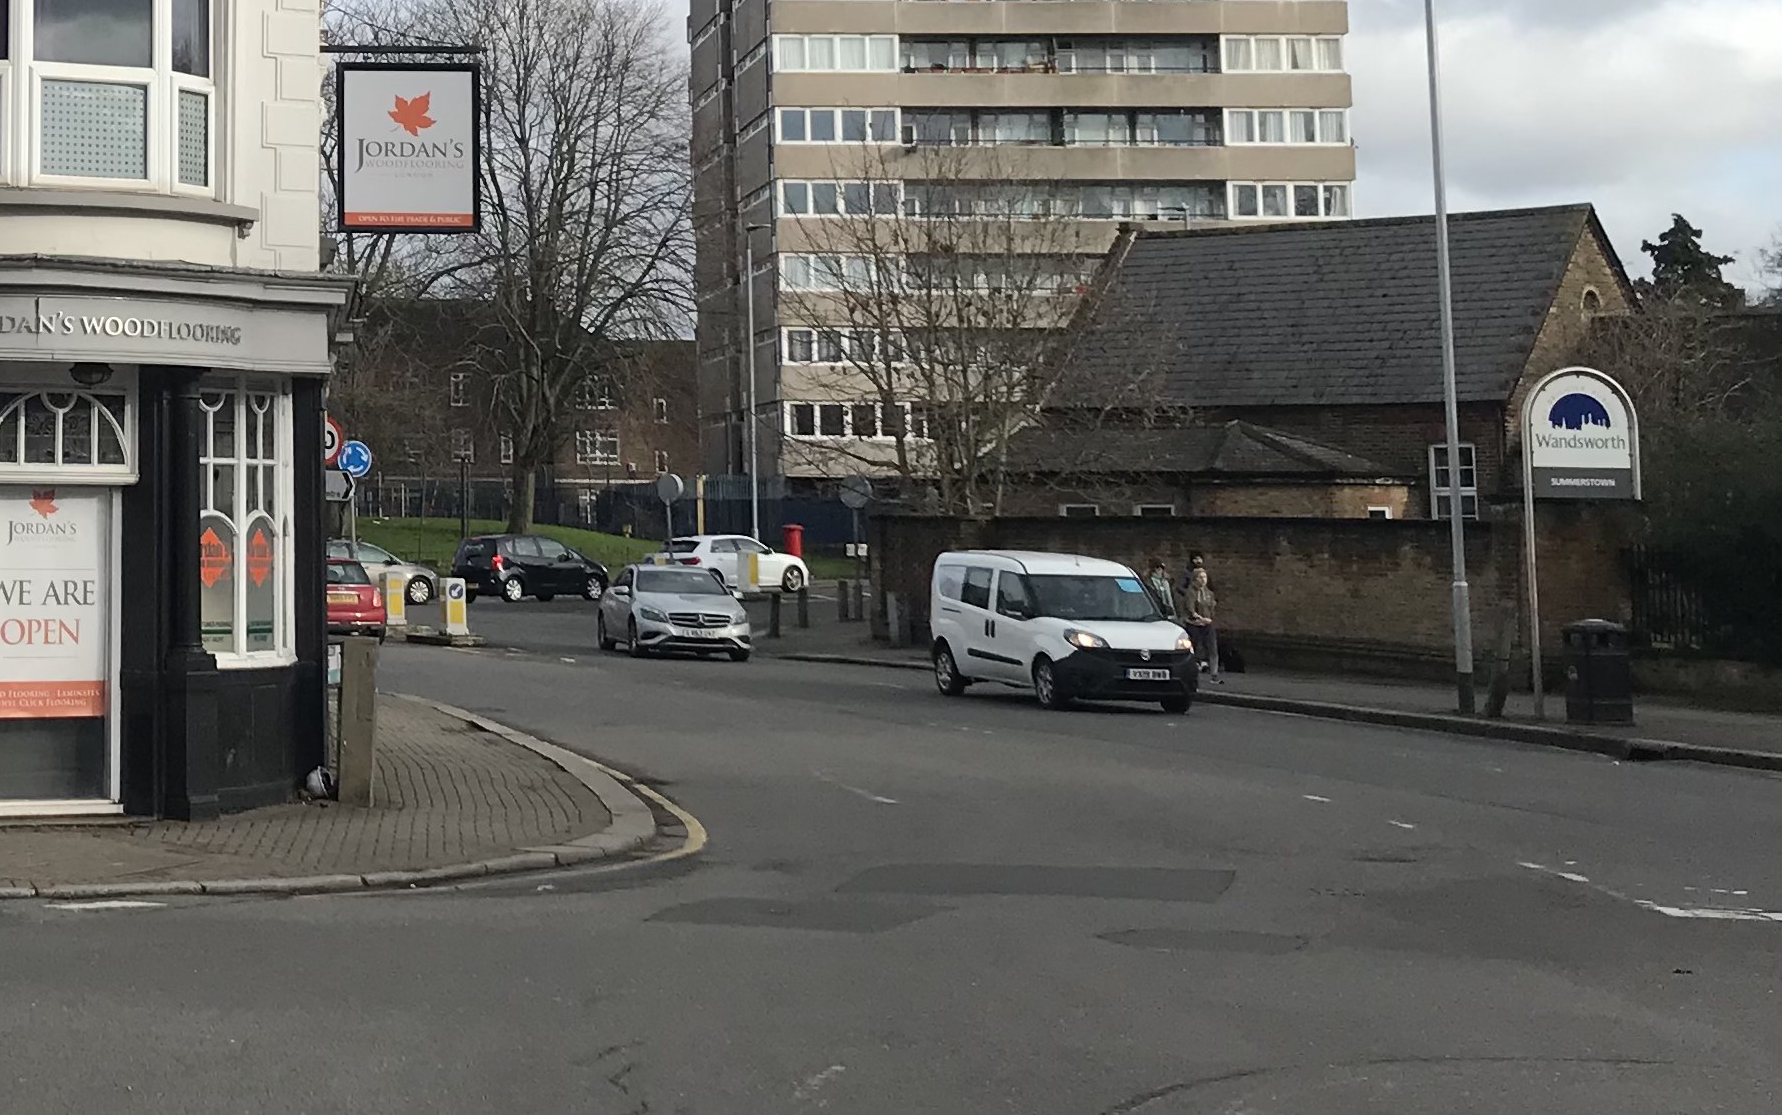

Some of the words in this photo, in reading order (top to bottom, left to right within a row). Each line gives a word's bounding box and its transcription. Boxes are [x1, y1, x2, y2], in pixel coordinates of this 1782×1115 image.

[355, 138, 464, 173] JORDAN'S
[365, 159, 465, 169] WOODFLOORING
[358, 214, 378, 222] OPEN
[81, 316, 243, 345] WOODFLOORING
[1535, 433, 1626, 450] Wandsworth
[1551, 477, 1615, 486] SUMMERSTOWN
[6, 520, 77, 546] JORDAN'S
[41, 579, 95, 606] ARE
[0, 618, 81, 645] OPEN
